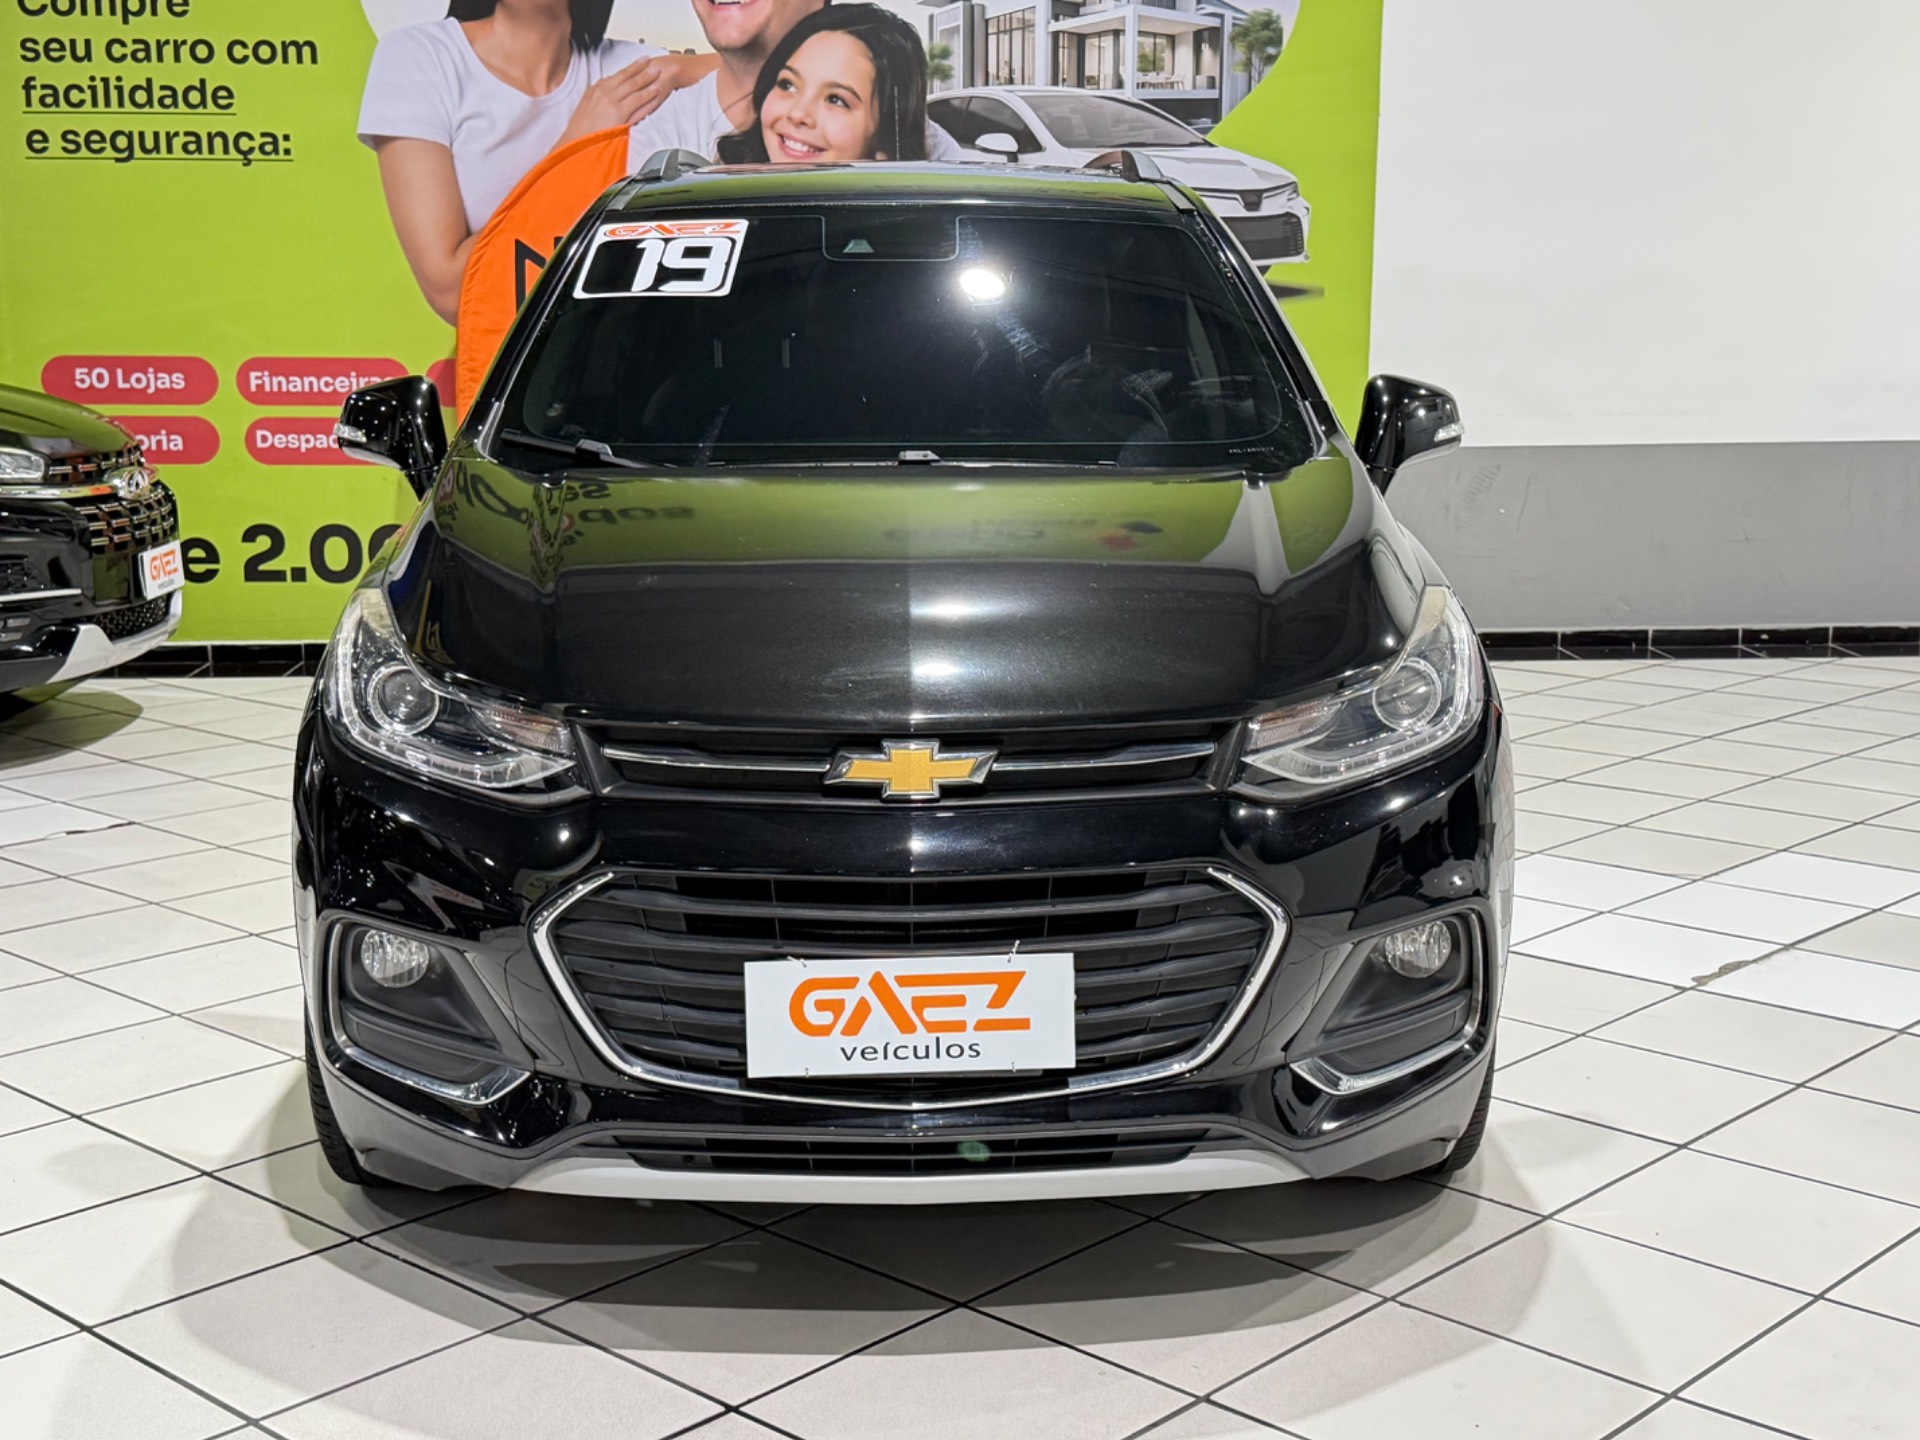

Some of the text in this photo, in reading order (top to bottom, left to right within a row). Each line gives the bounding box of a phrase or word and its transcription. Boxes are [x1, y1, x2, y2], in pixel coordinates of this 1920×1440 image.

[19, 37, 318, 65] seu carro com
[22, 75, 235, 110] facilidade
[25, 129, 293, 167] e segurança:
[631, 238, 732, 292] 19
[74, 367, 186, 394] 50 Lojas
[249, 371, 395, 393] Financeir
[788, 970, 1031, 1038] GAEZ
[839, 1036, 981, 1062] veículos
